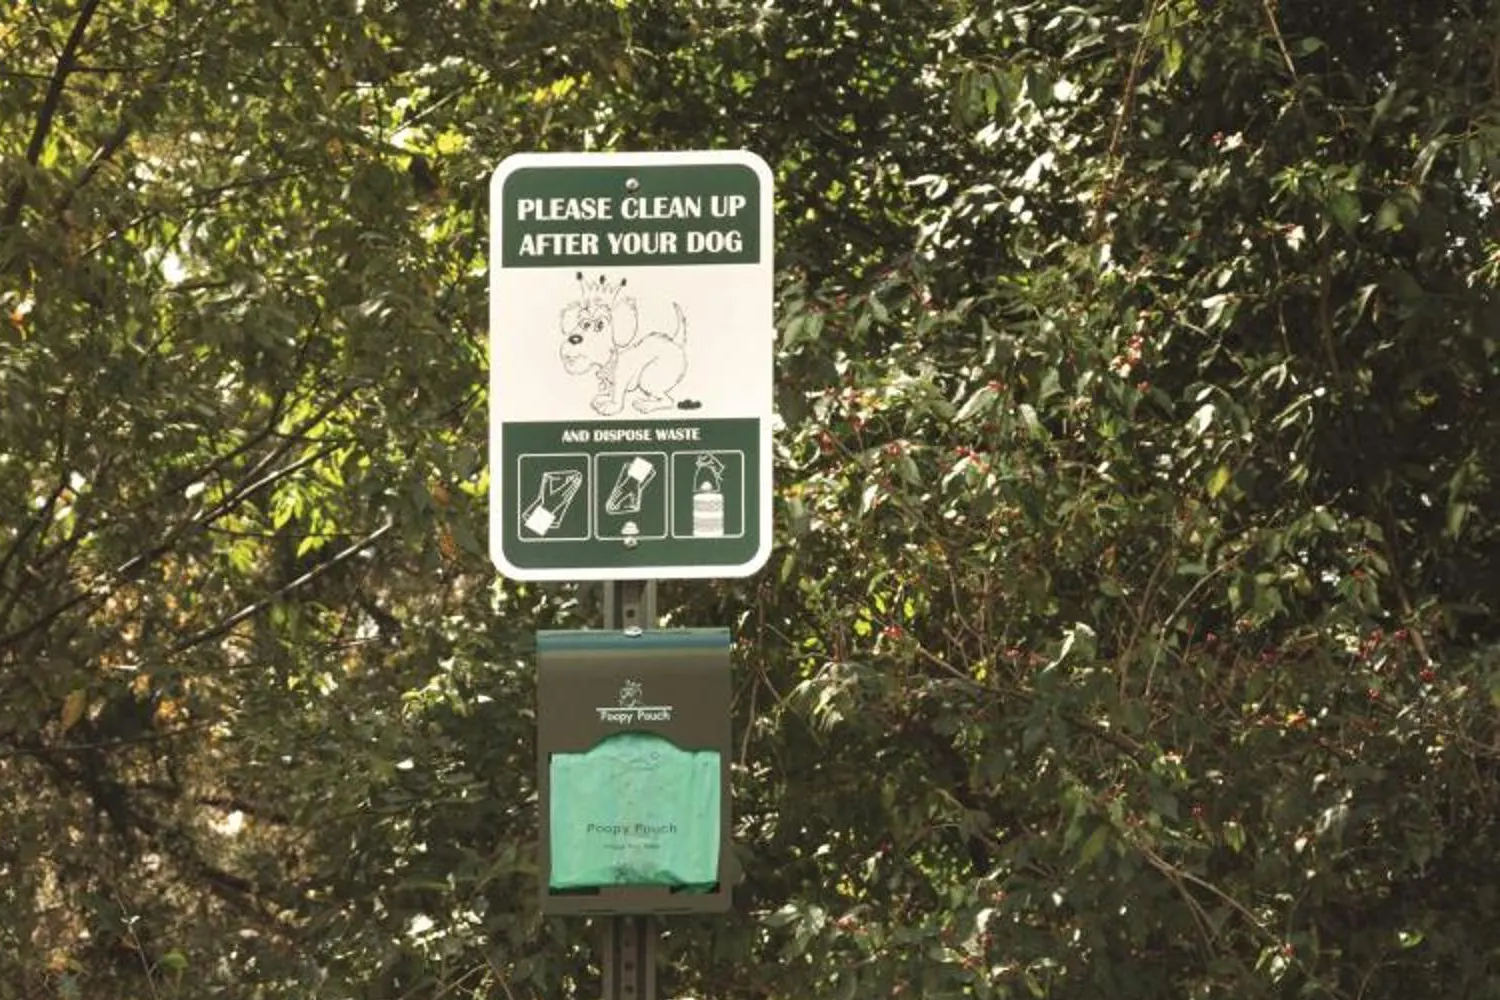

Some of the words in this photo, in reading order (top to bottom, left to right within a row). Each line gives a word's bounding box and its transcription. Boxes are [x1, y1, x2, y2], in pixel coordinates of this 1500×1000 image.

[517, 197, 612, 221] PLEASE
[621, 196, 701, 219] CLEAN
[711, 195, 747, 217] UP
[519, 233, 599, 255] AFTER
[607, 232, 677, 254] YOUR
[687, 230, 743, 253] DOG
[562, 429, 589, 442] AND
[594, 428, 652, 441] DISPOSE
[655, 427, 701, 441] WASTE
